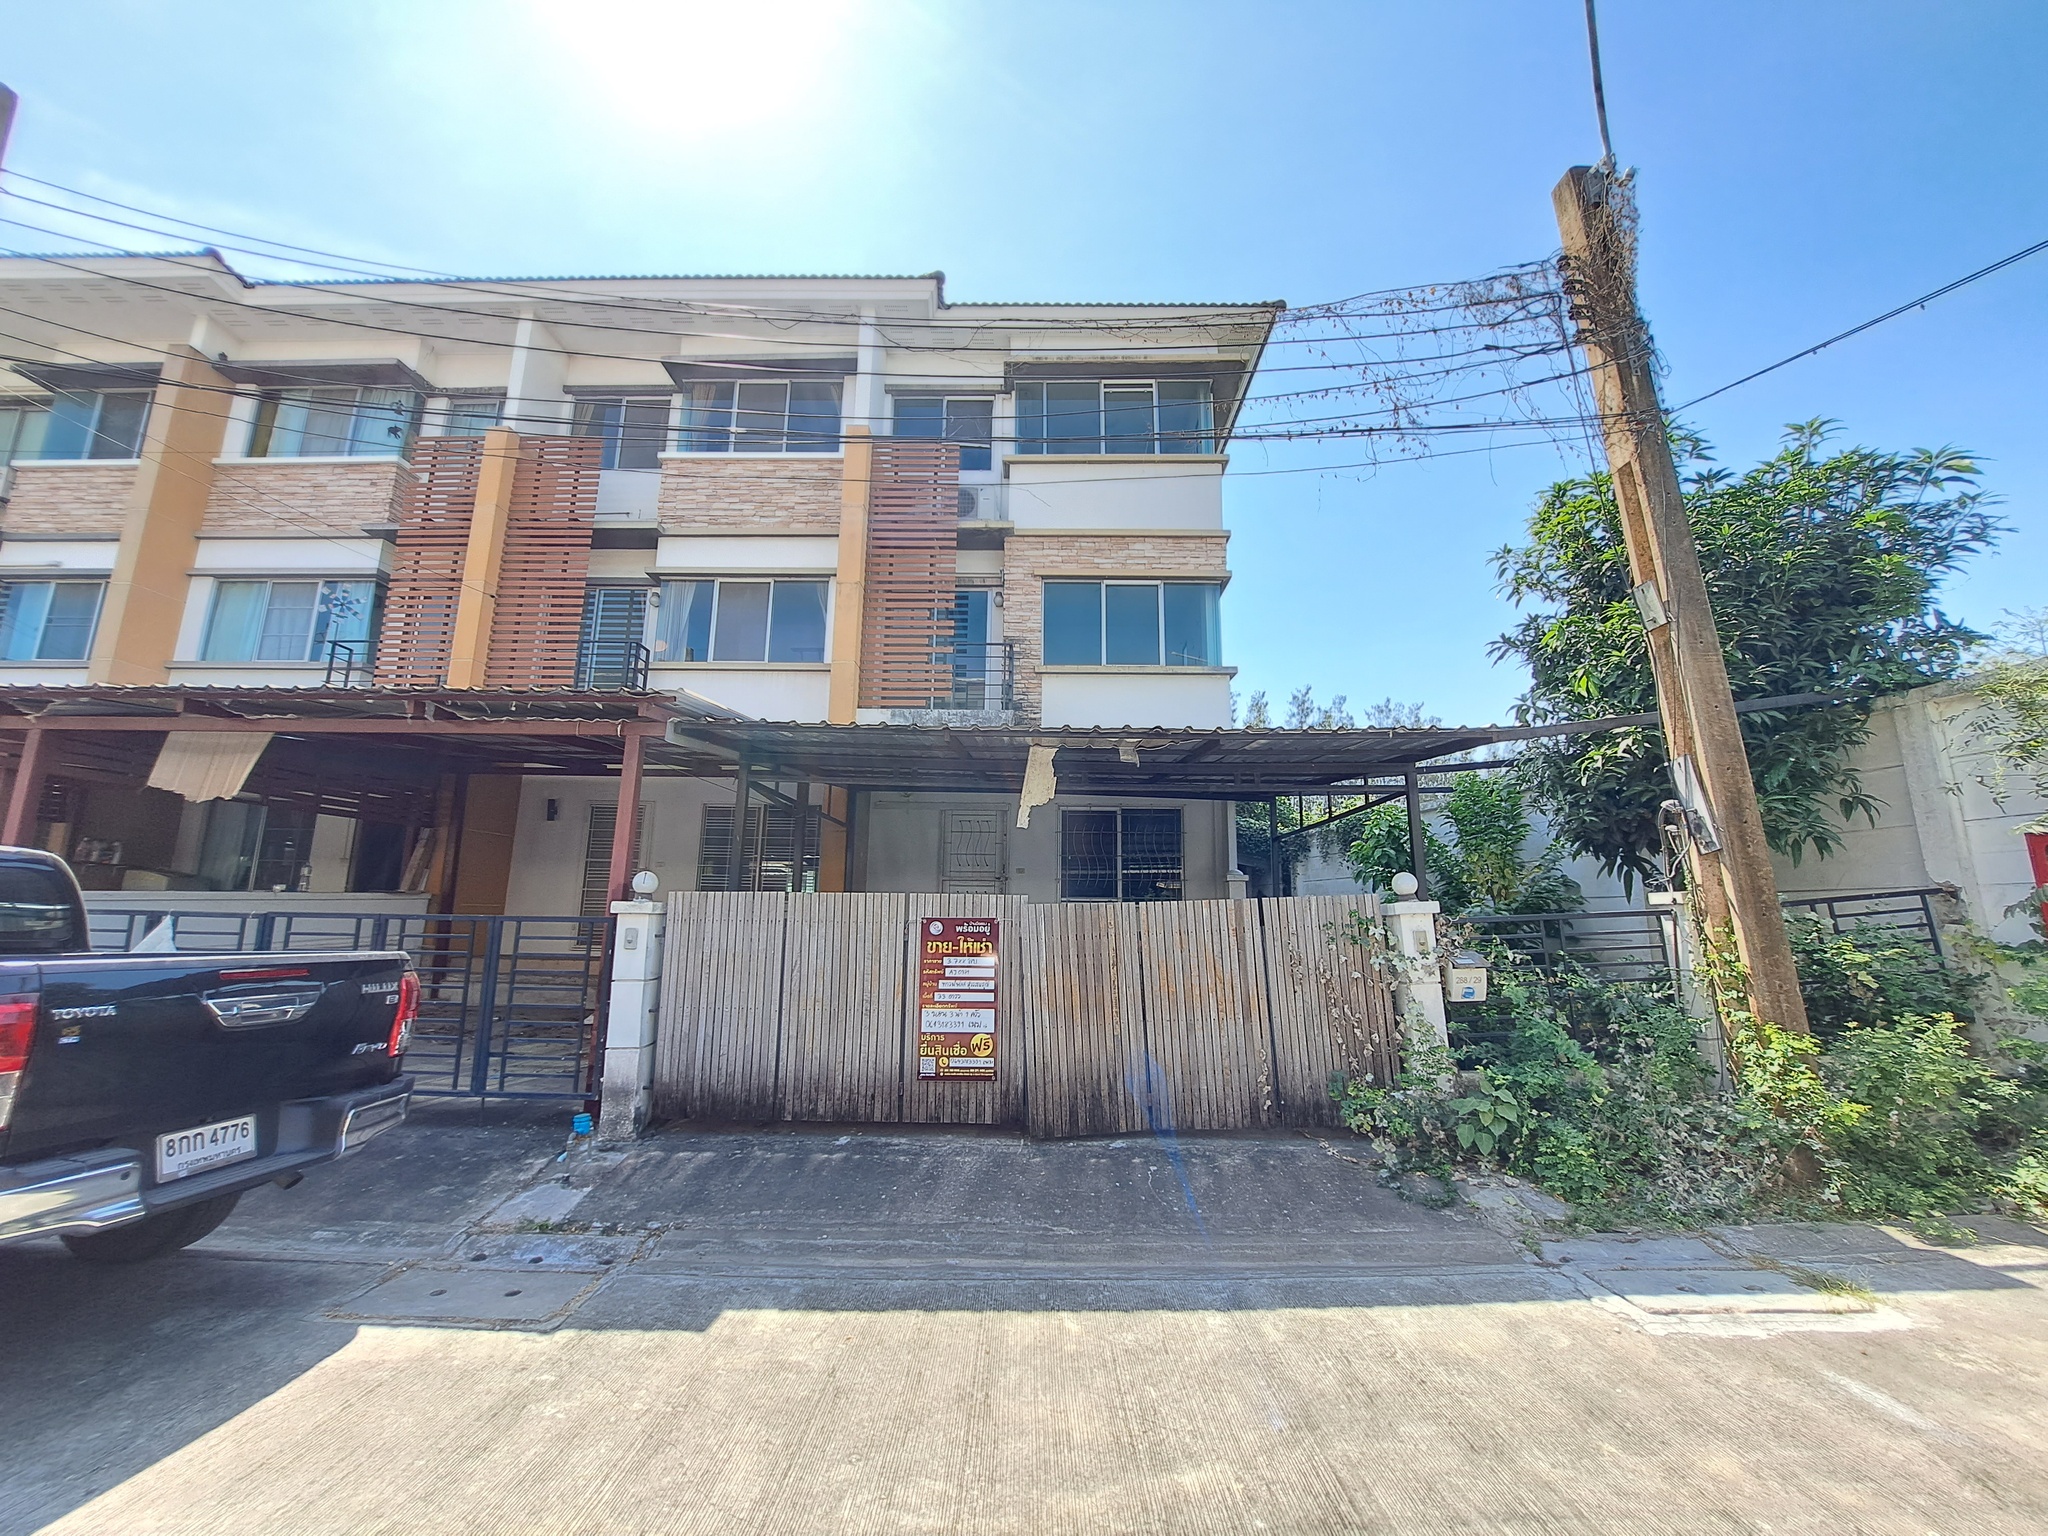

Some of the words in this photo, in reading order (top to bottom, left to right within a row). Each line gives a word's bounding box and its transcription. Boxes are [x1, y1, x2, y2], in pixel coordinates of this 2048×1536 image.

[955, 922, 991, 935] พร้อมอยู่
[926, 936, 993, 954] ขาย-ให้เช่า
[50, 1005, 117, 1020] TOYOTA
[921, 1033, 945, 1041] บริการ
[919, 1041, 968, 1056] ยื่นสินเชื่อ
[165, 1131, 205, 1157] 8กก
[210, 1121, 250, 1146] 4776
